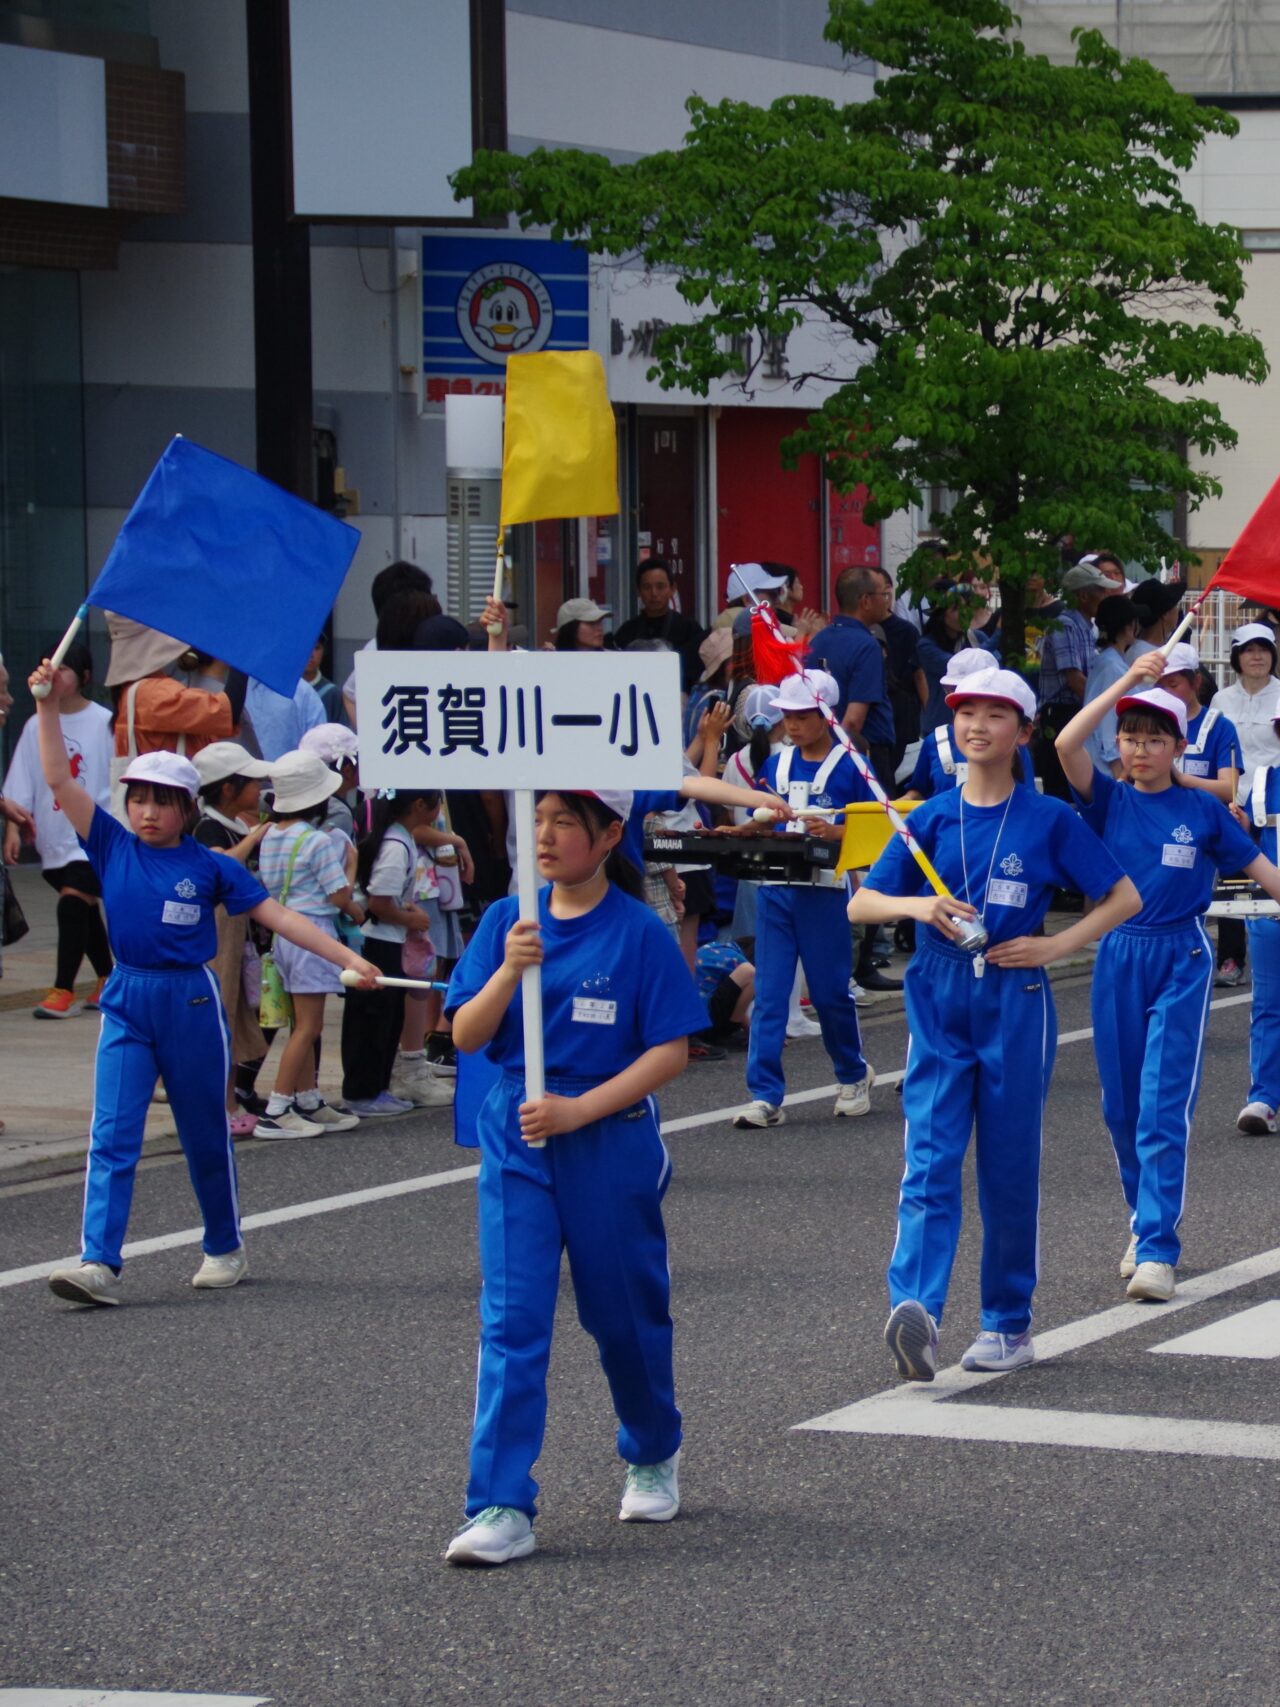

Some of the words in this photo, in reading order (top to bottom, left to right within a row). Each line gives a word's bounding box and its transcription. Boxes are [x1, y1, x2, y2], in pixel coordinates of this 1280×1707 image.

[381, 683, 660, 757] 須賀川一小
[653, 838, 683, 850] YAMAHA
